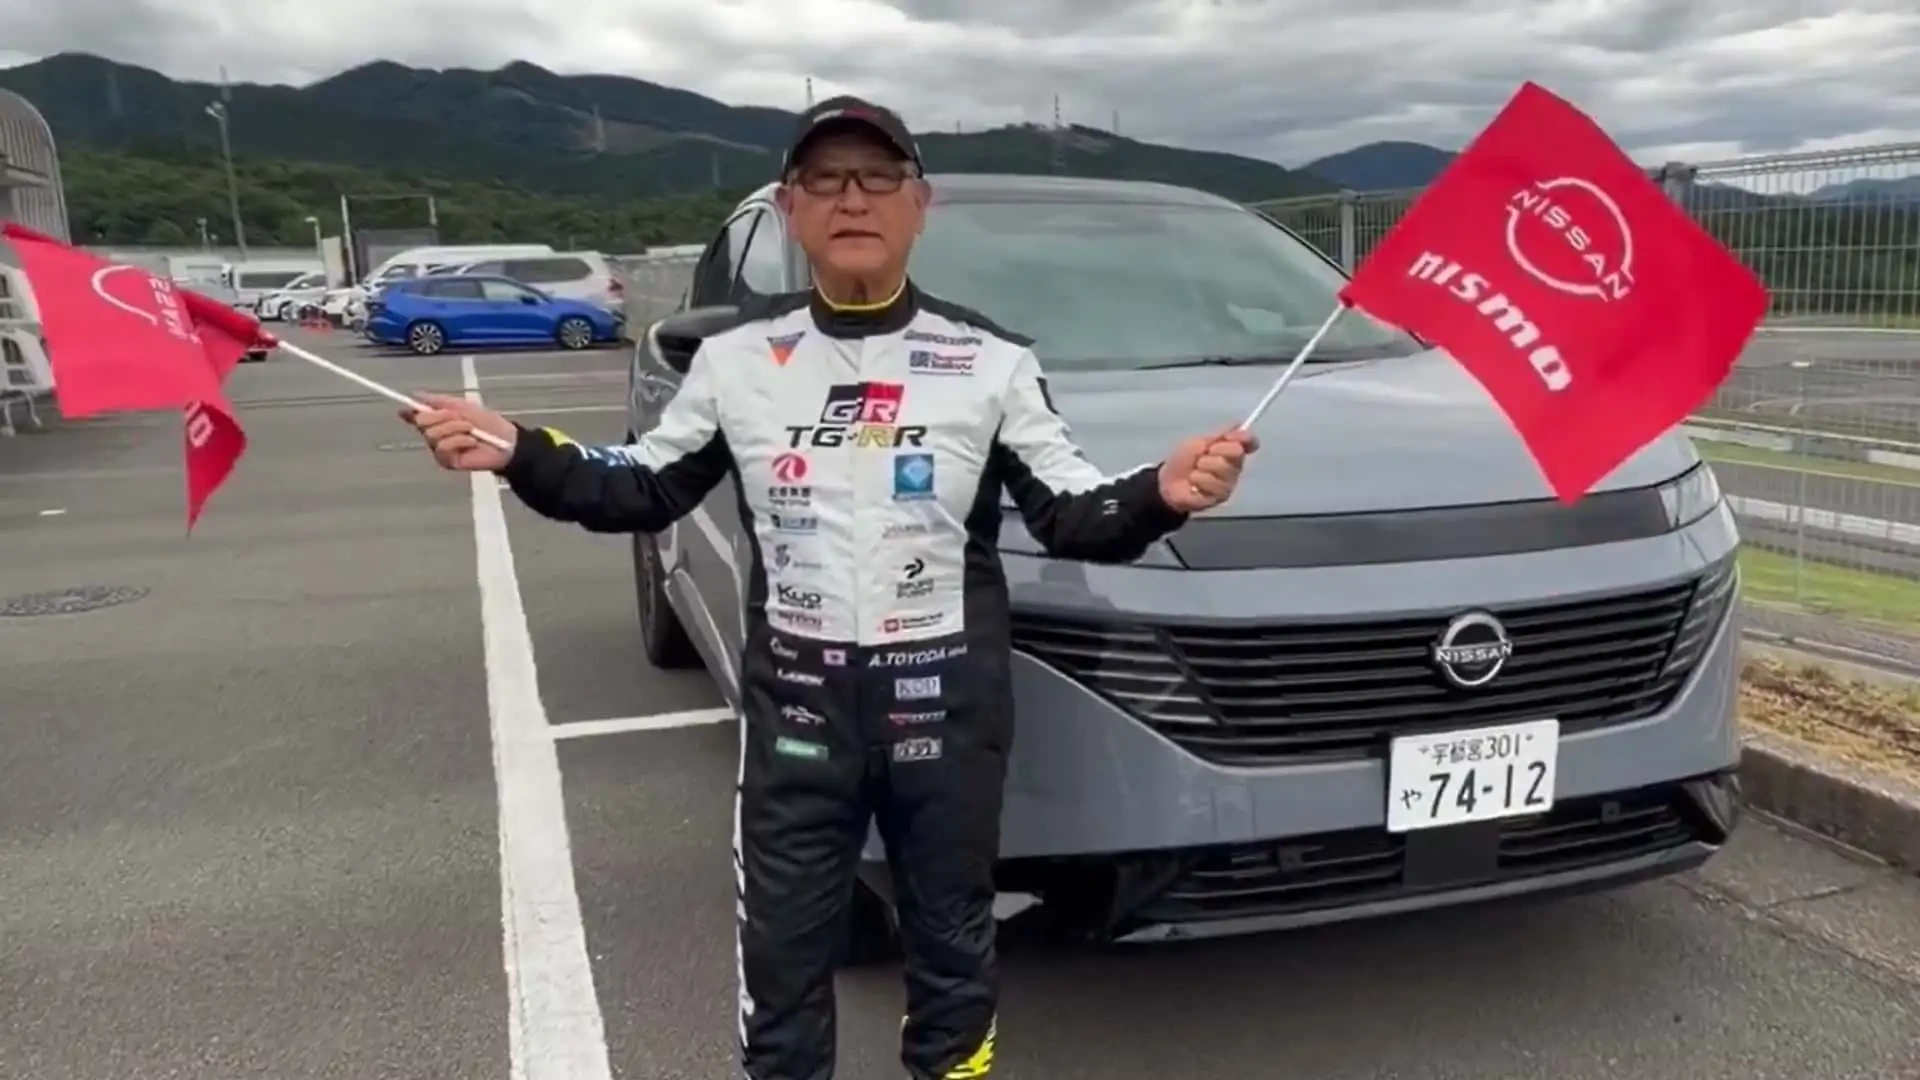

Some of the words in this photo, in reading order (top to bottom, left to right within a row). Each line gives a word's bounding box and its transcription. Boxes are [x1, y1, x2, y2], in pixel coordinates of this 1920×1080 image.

[1512, 189, 1630, 300] NISSAN
[1408, 250, 1572, 391] nismo
[1434, 642, 1513, 662] NISSAN
[1401, 789, 1422, 809] や
[1429, 760, 1547, 818] 74-12
